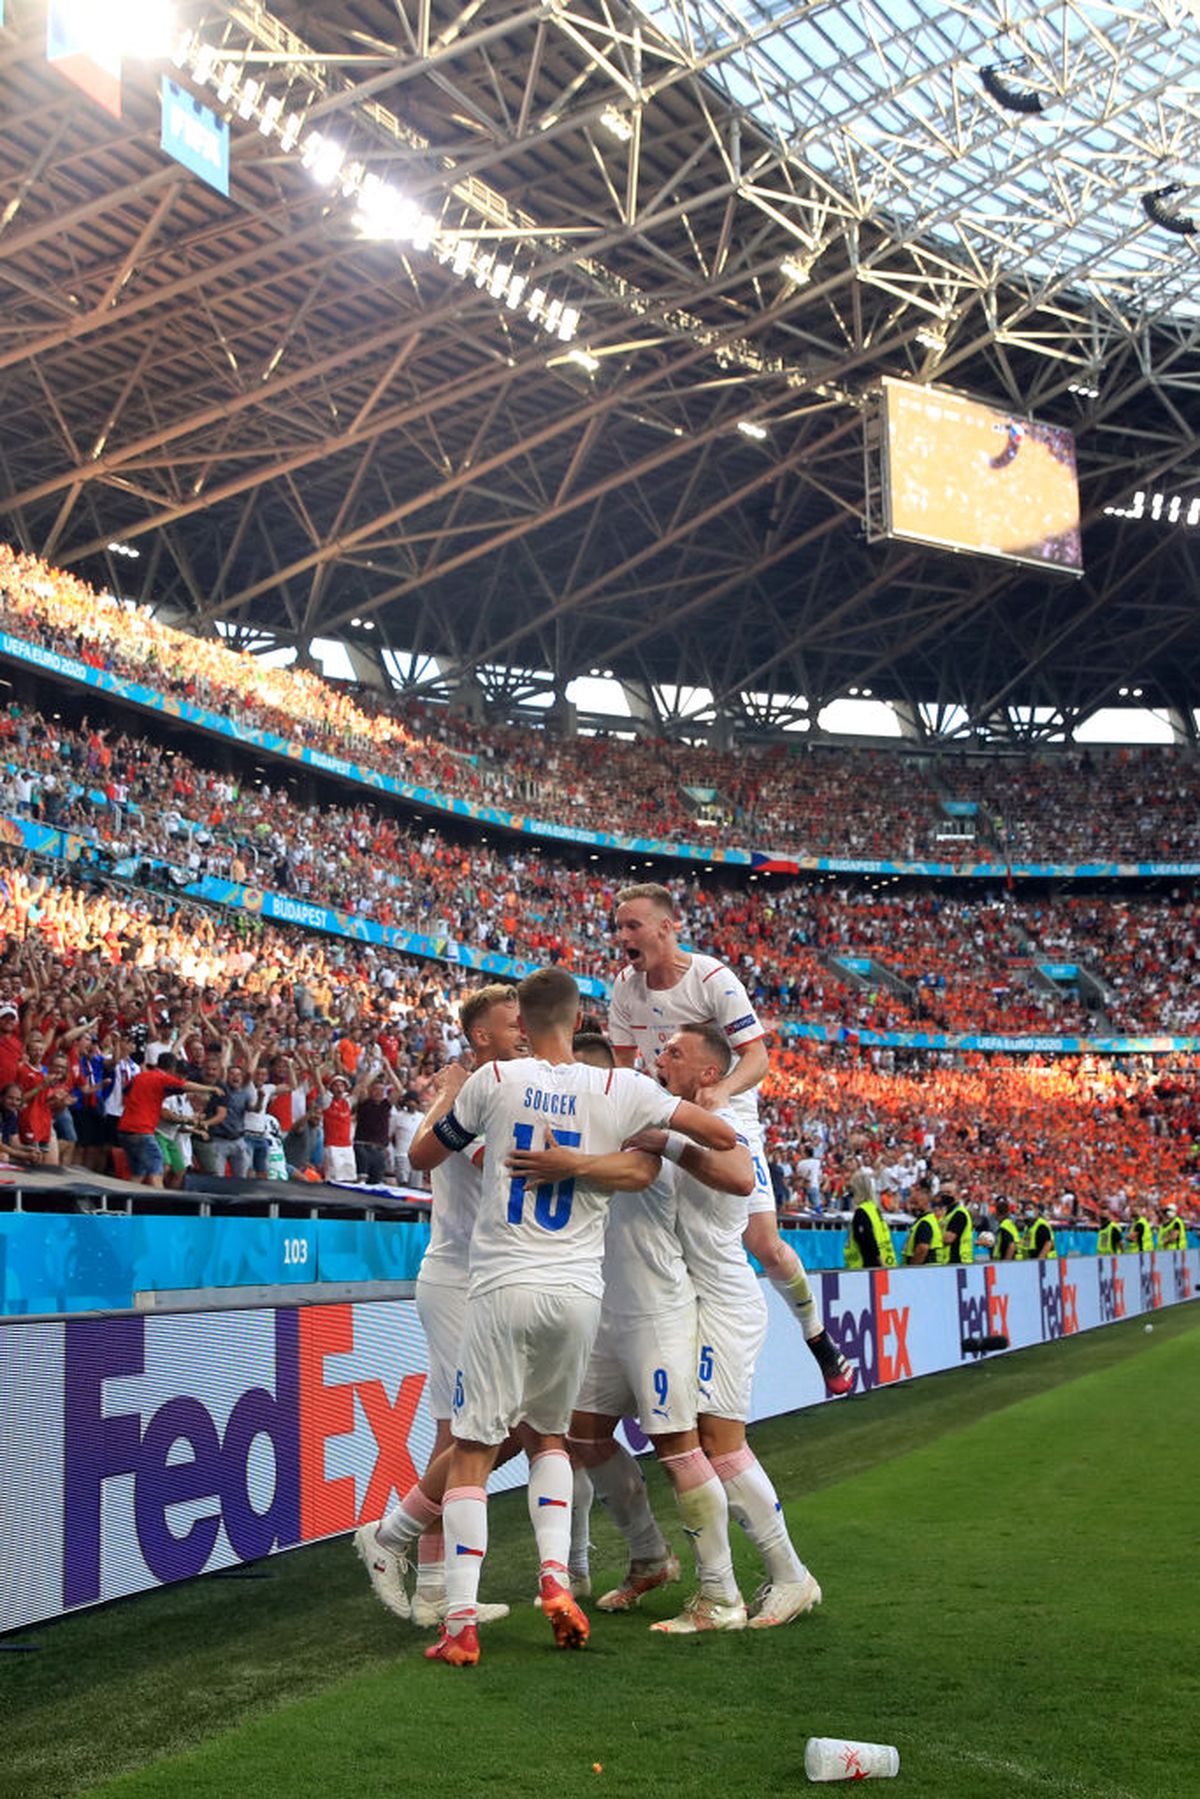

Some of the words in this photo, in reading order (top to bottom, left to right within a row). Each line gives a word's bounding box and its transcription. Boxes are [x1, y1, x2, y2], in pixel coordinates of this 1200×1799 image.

[4, 635, 33, 660] UEFA
[32, 645, 60, 671] EURO
[61, 657, 87, 680] 2020
[310, 750, 350, 777] BUDAPEST
[273, 897, 327, 928] BUDAPEST
[976, 1037, 1005, 1050] UEFA
[1005, 1038, 1034, 1051] EURO
[1035, 1039, 1063, 1051] 2020
[507, 1122, 581, 1231] 15
[283, 1238, 308, 1264] 103
[956, 1265, 1011, 1360] FedEx
[1038, 1257, 1079, 1340] FedEx
[821, 1269, 913, 1399] FedEx
[699, 1345, 714, 1382] 5
[653, 1368, 669, 1406] 9
[64, 1303, 428, 1608] FedEx
